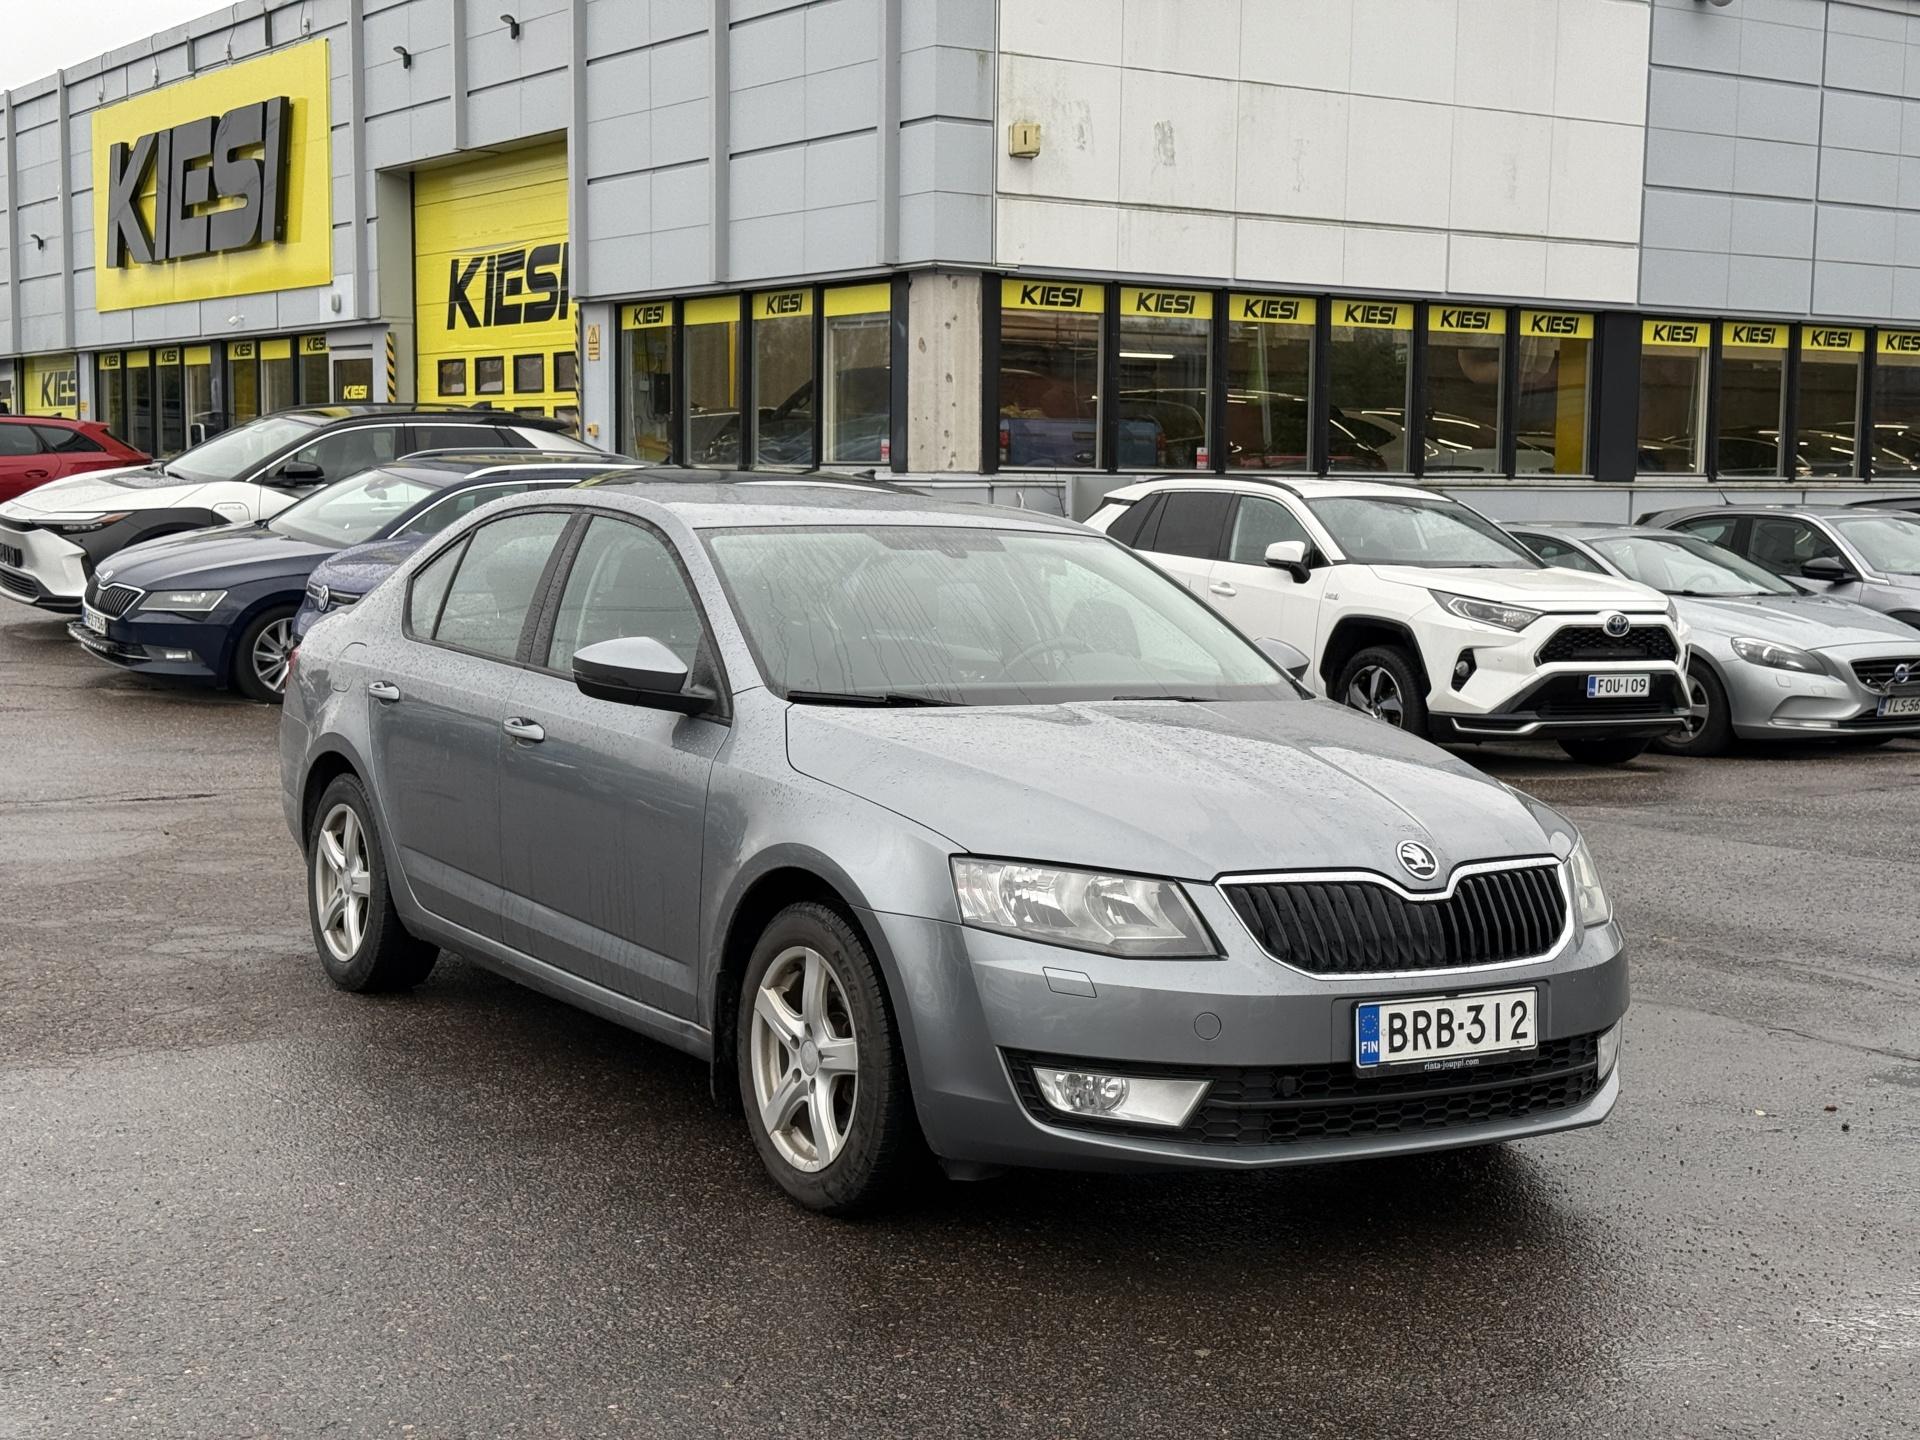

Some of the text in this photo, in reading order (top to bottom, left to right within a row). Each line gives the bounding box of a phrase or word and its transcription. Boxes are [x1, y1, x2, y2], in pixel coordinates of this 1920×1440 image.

[107, 96, 290, 269] KIESI
[447, 242, 569, 330] KIESI
[1020, 284, 1083, 307] KIESI
[765, 293, 803, 315] KIESI
[1136, 292, 1196, 314] KIESI
[1243, 299, 1299, 319] KIESI
[633, 305, 664, 325] KIESI
[1344, 304, 1398, 325] KIESI
[1440, 310, 1491, 329] KIESI
[1531, 315, 1579, 334] KIESI
[1653, 324, 1698, 343] KIESI
[1732, 326, 1776, 344] KIESI
[1810, 330, 1852, 348] KIESI
[344, 385, 368, 399] KIESI
[1598, 678, 1647, 693] FOU-109
[1388, 1000, 1528, 1053] BRB-312
[1361, 1041, 1379, 1054] FIN
